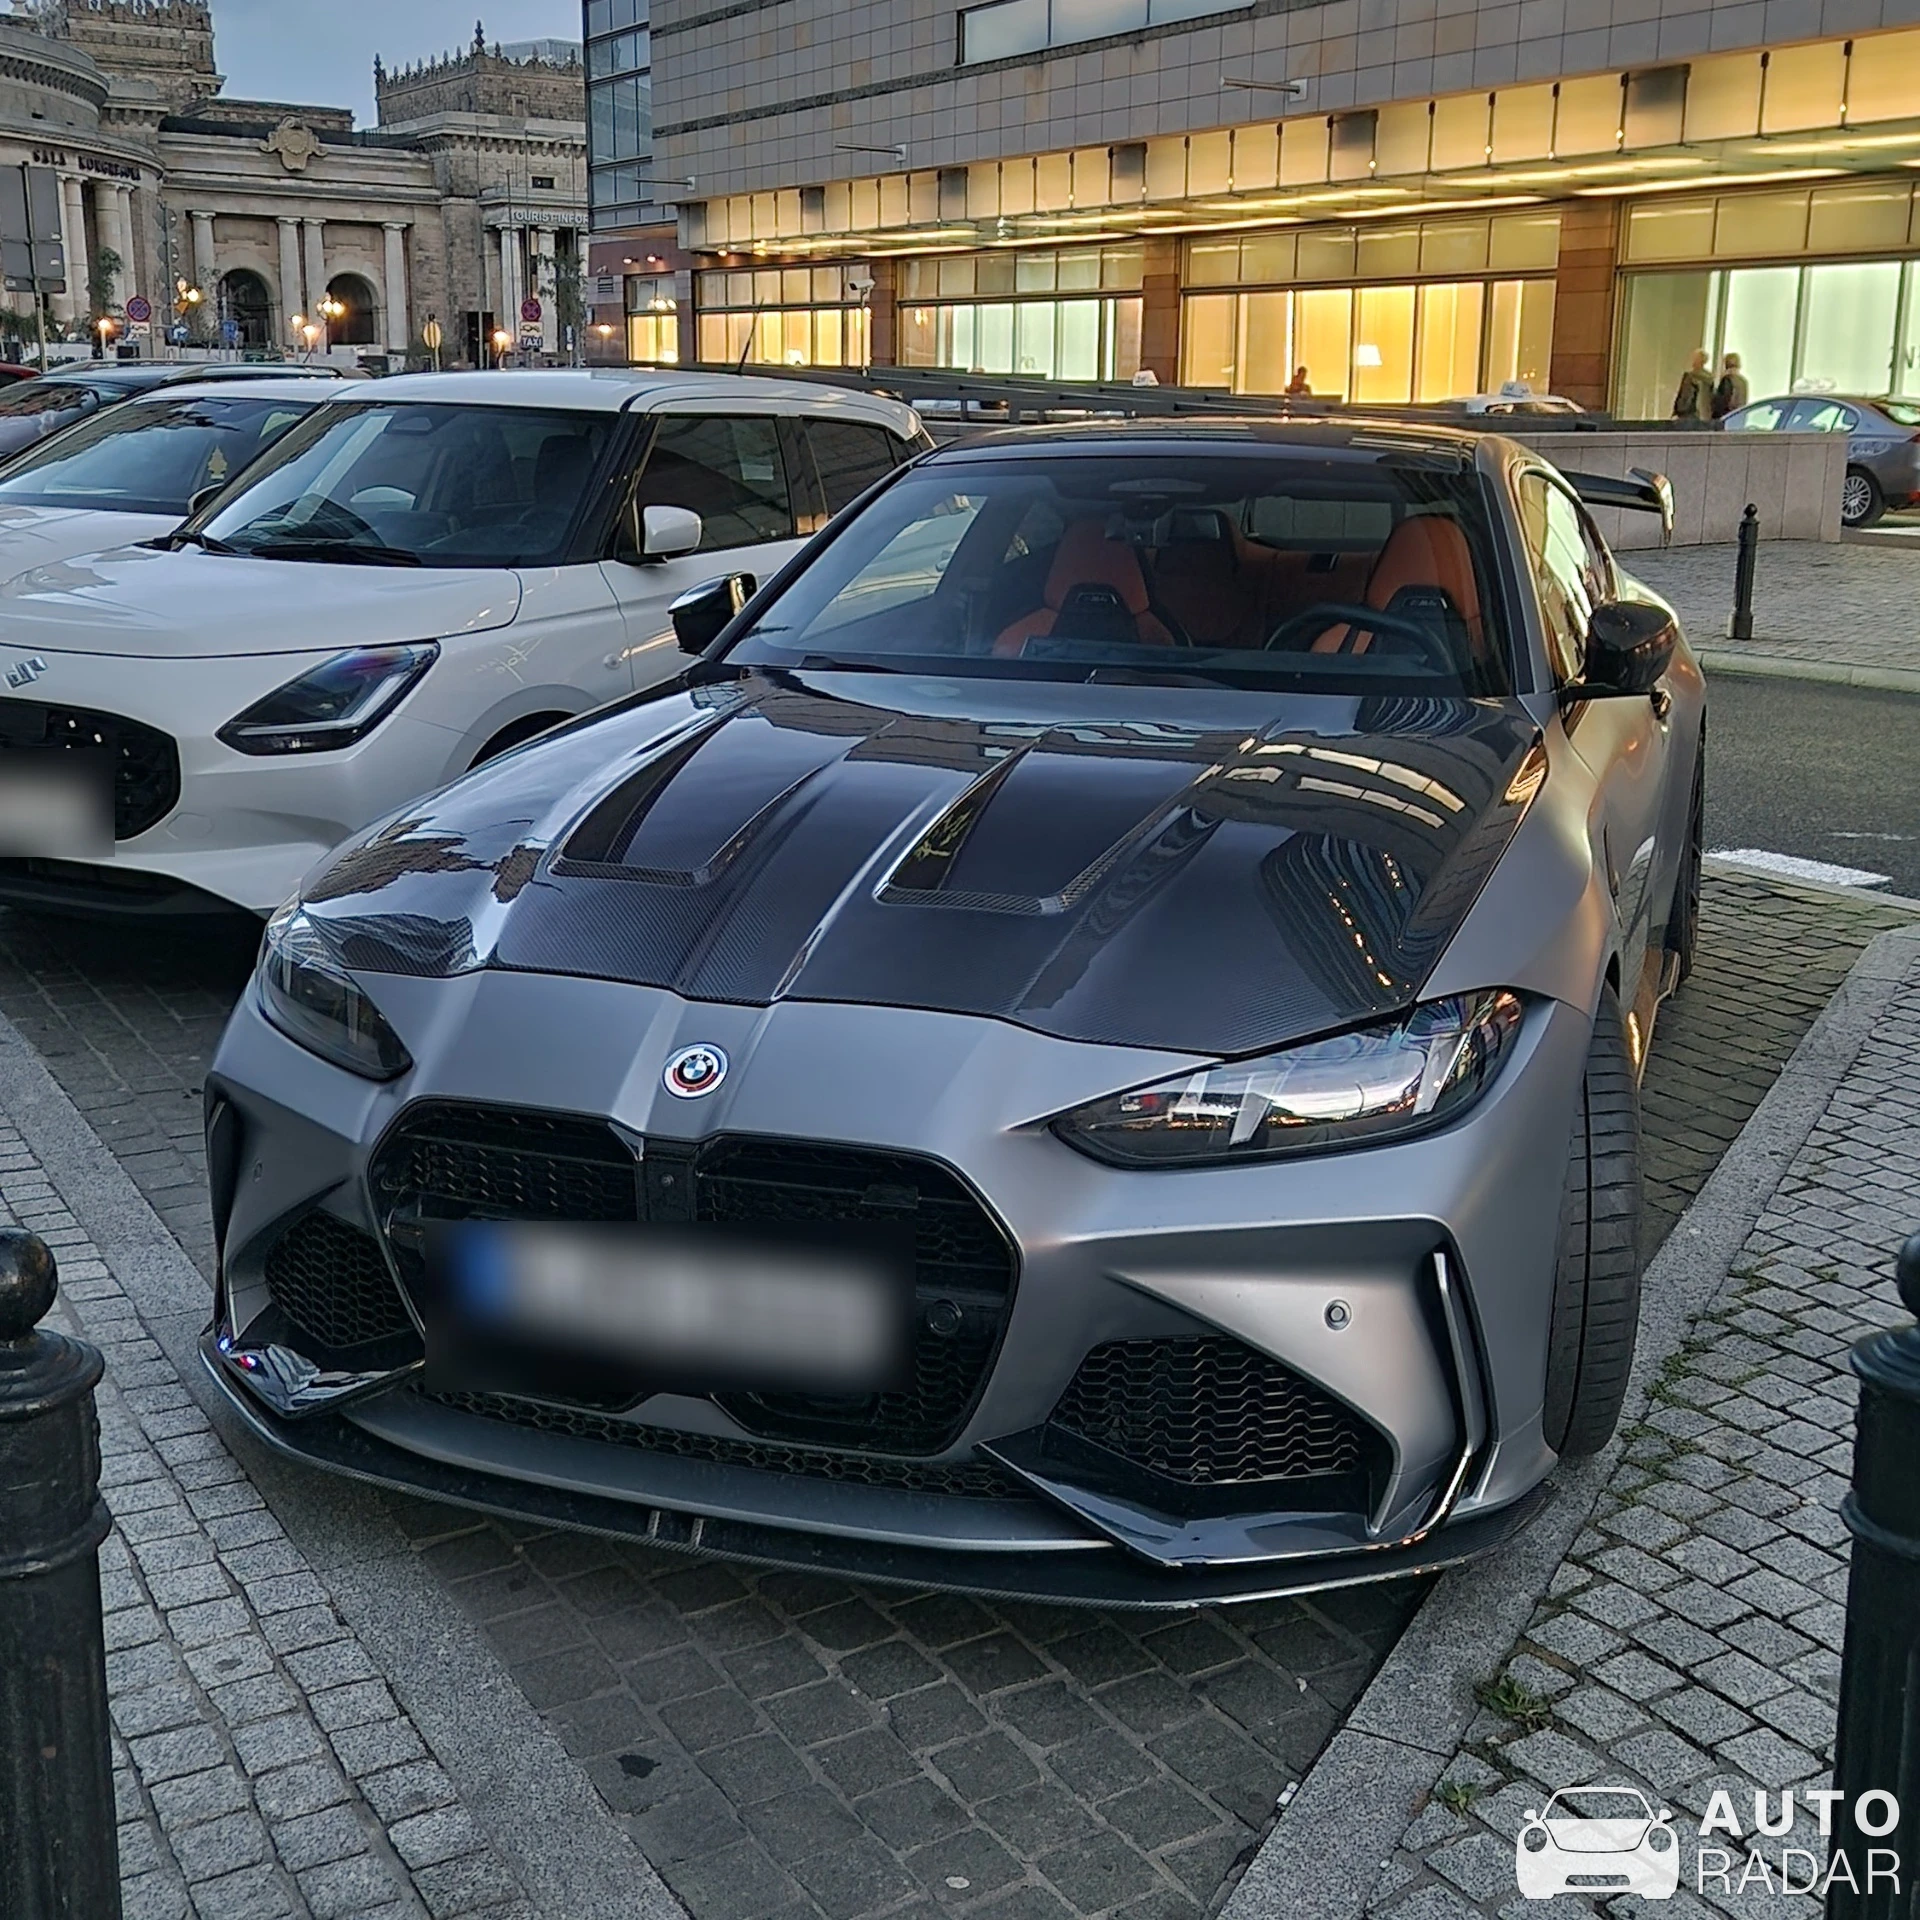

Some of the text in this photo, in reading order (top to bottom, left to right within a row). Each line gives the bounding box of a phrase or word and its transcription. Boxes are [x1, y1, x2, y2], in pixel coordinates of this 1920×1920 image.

[33, 149, 66, 166] SALA
[511, 209, 556, 222] TOURIST
[522, 336, 542, 347] TAXI
